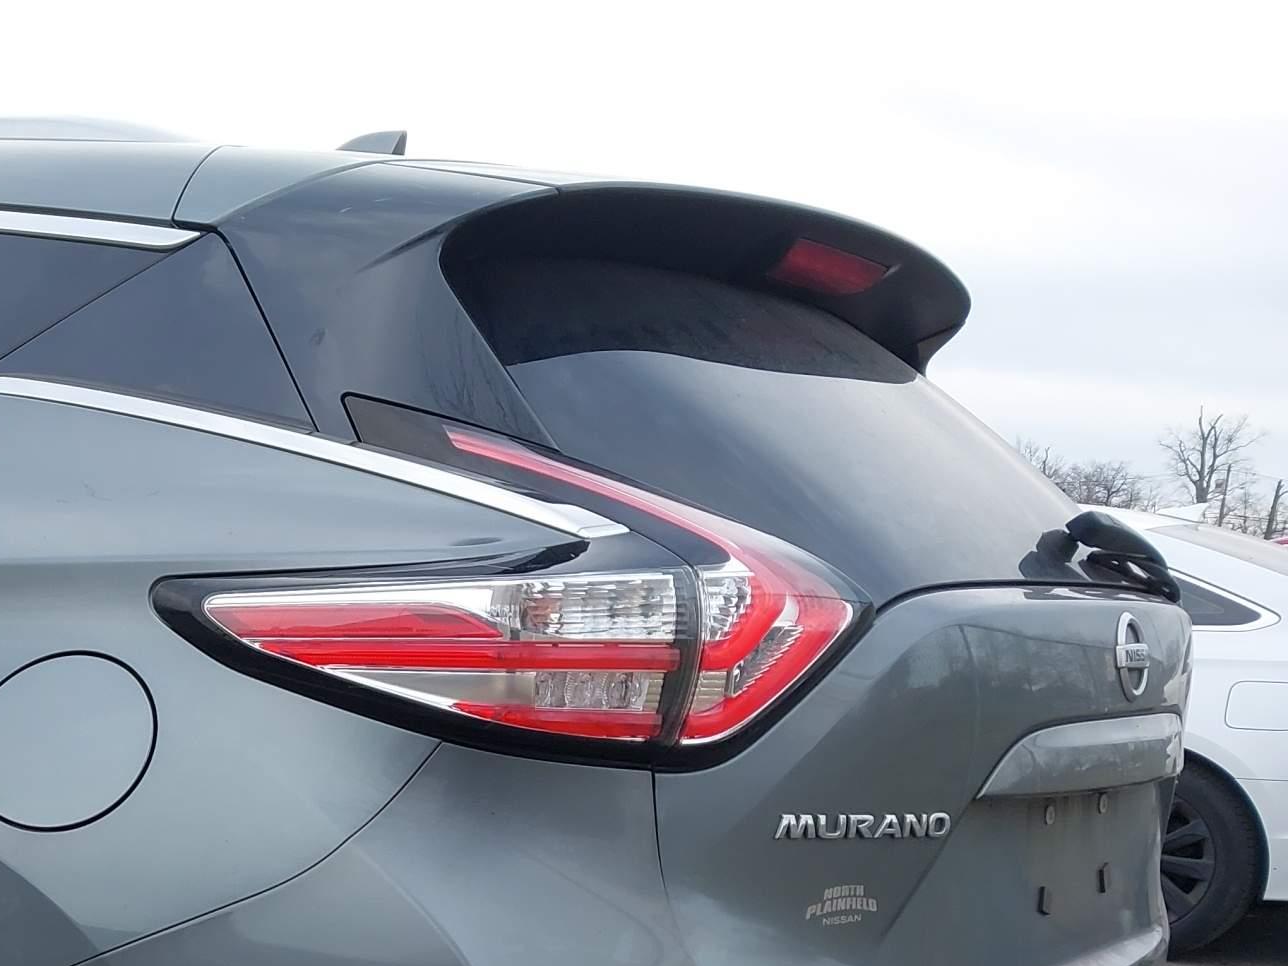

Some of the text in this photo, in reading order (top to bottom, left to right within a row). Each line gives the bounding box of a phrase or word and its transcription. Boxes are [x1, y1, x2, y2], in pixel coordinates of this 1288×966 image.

[774, 812, 952, 840] MURANO
[823, 884, 865, 901] NORTH
[805, 897, 878, 920] PLAINFIELD
[822, 914, 862, 926] NISSAN
